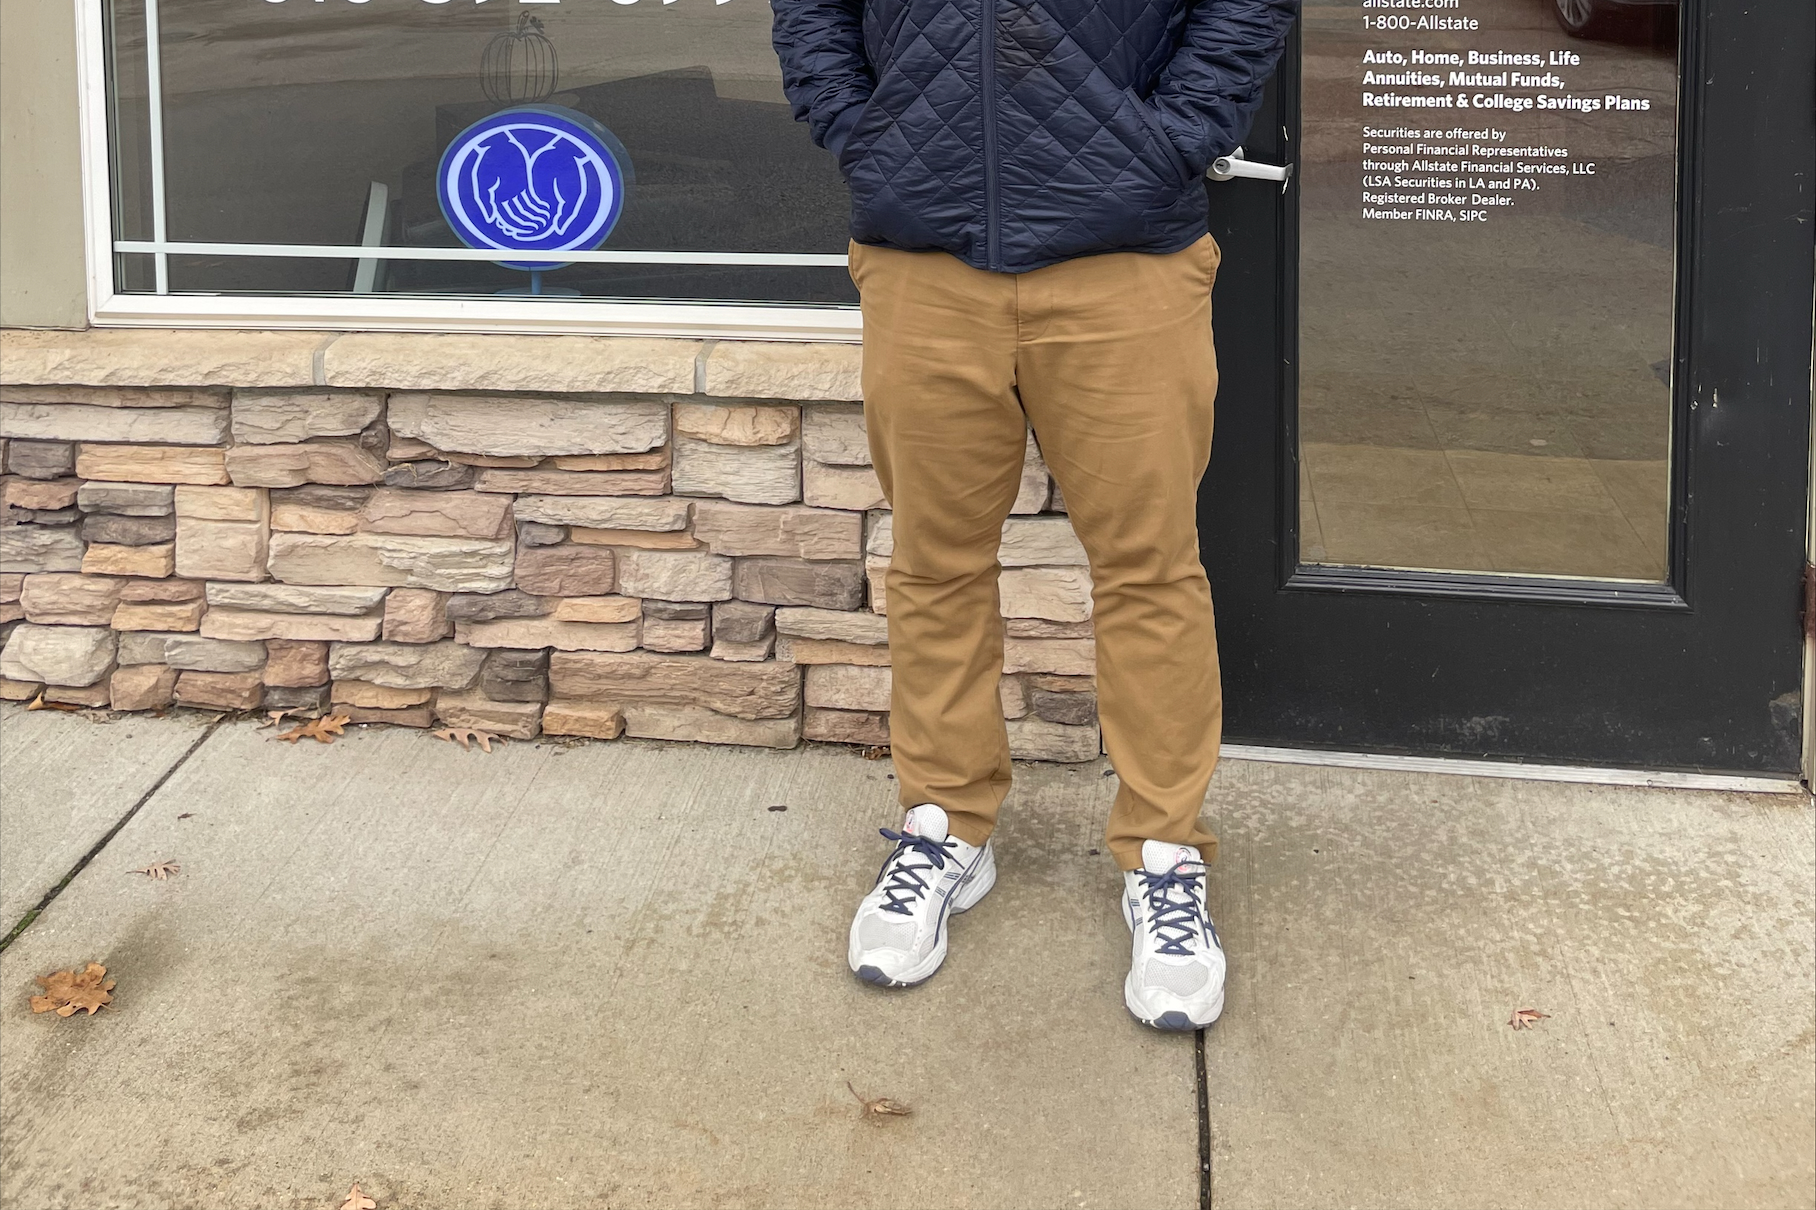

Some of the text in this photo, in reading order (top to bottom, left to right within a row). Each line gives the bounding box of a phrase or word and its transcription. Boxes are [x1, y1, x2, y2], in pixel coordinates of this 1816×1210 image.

[1363, 16, 1479, 30] 1-800-Allstate
[1363, 49, 1580, 67] Auto, Home, Business, Life
[1363, 71, 1565, 89] Annuities, Mutual Funds,
[1363, 93, 1650, 112] Retirement & College Savings Plans
[1363, 127, 1506, 142] Securities are offered by
[1363, 143, 1568, 158] Personal Financial Representatives
[1363, 159, 1595, 176] through Allstate Financial Services, LLC
[1363, 176, 1539, 191] (LSA Securities in LA and PA).
[1363, 192, 1514, 206] Registered Broker Dealer.
[1363, 208, 1487, 223] Member FINRA, SIPC
